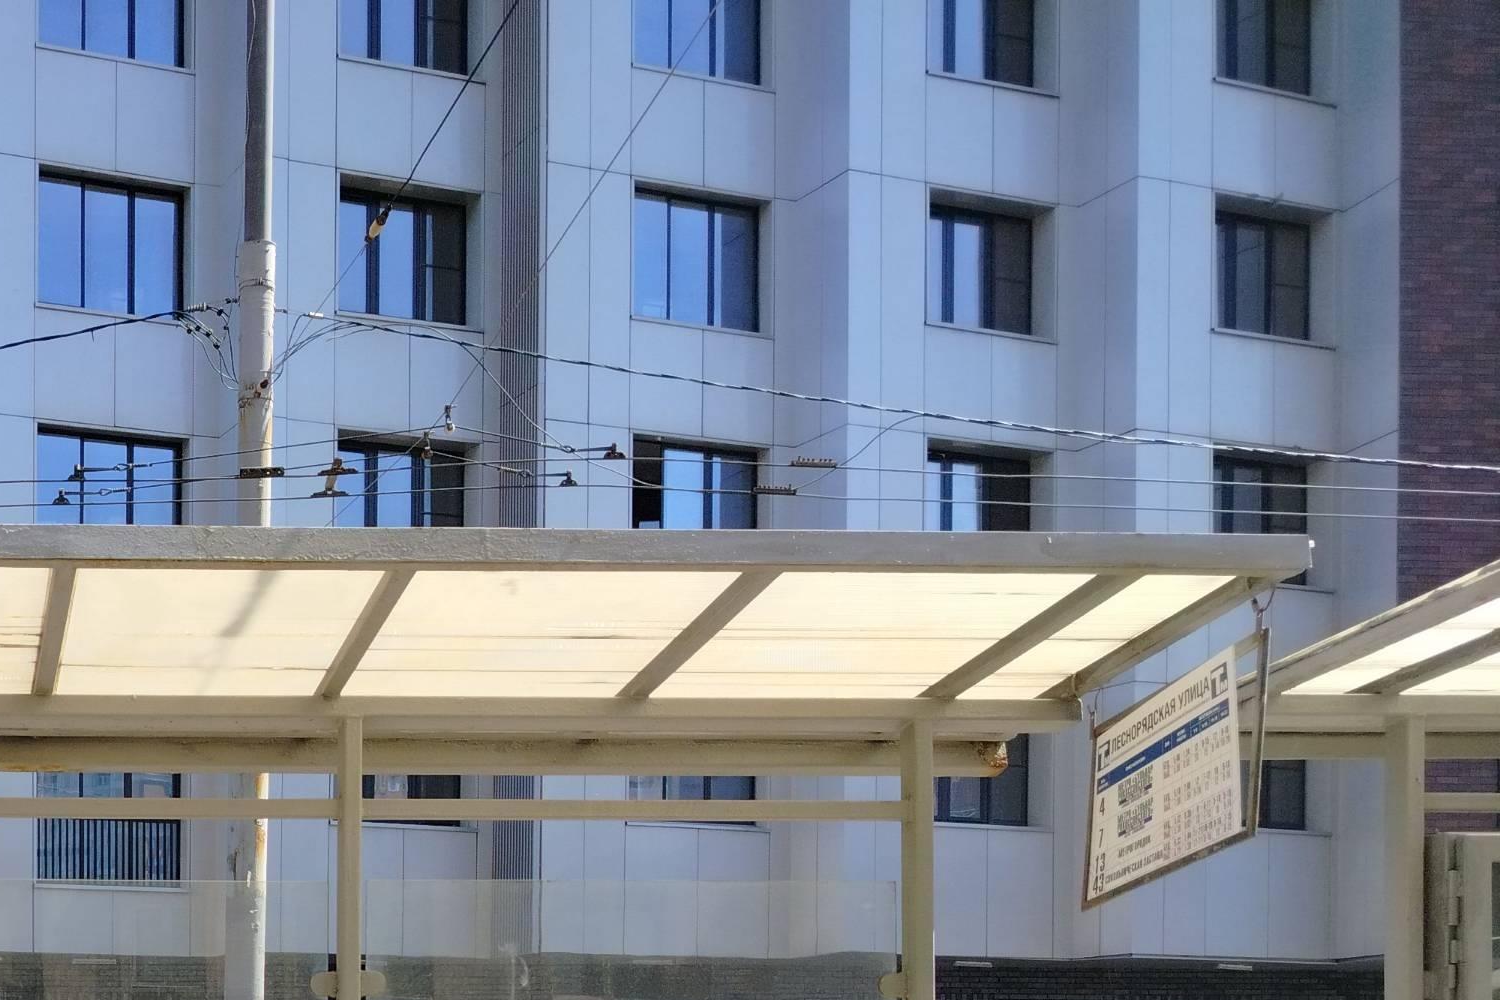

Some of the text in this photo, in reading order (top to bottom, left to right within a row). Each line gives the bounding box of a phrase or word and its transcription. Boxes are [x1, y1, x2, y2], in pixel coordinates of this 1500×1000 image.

[1111, 699, 1175, 754] ЛЕСНОРЯДСКАЯ
[1178, 676, 1209, 709] УЛИЦА
[1099, 795, 1105, 818] 4
[1098, 827, 1103, 849] 7
[1094, 851, 1105, 875] 13
[1091, 871, 1104, 896] 43
